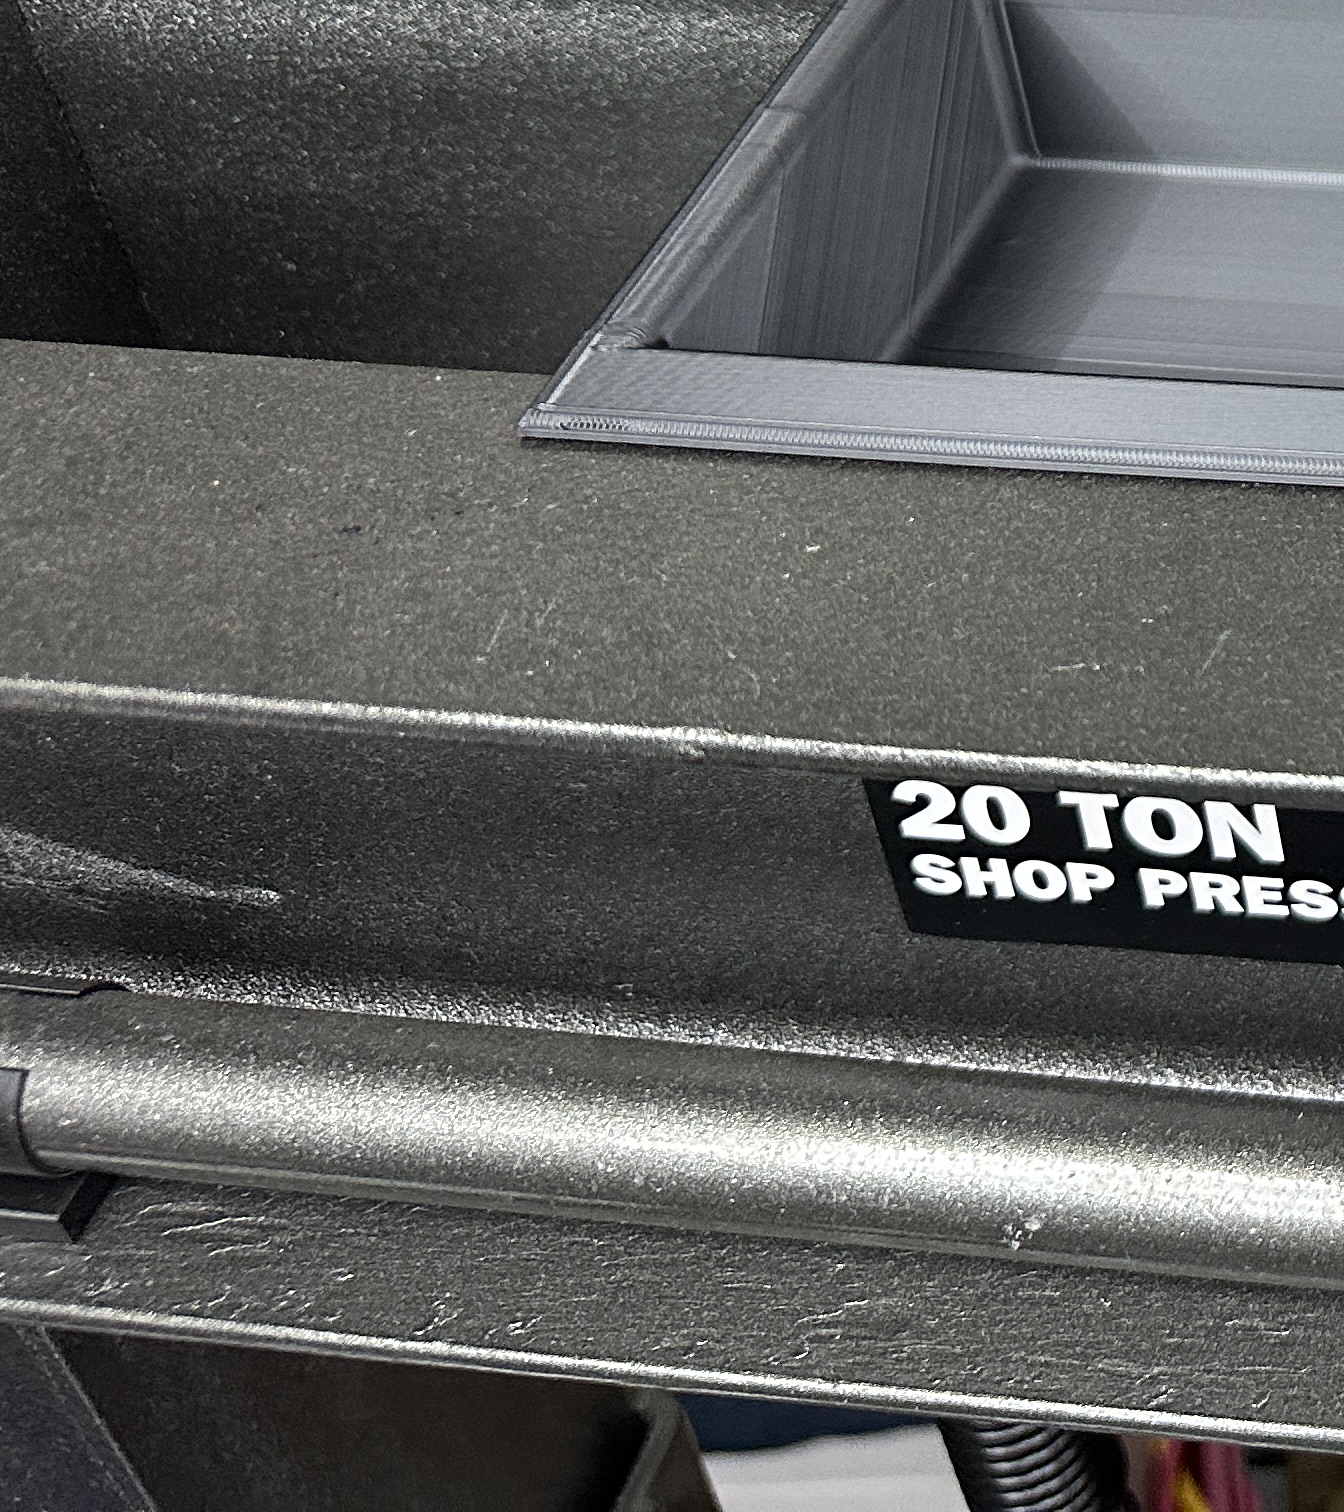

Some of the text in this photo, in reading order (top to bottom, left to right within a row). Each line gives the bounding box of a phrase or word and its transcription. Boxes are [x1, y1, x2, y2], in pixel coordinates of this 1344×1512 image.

[891, 779, 1286, 865] 20 TON
[910, 853, 1116, 903] SHOP
